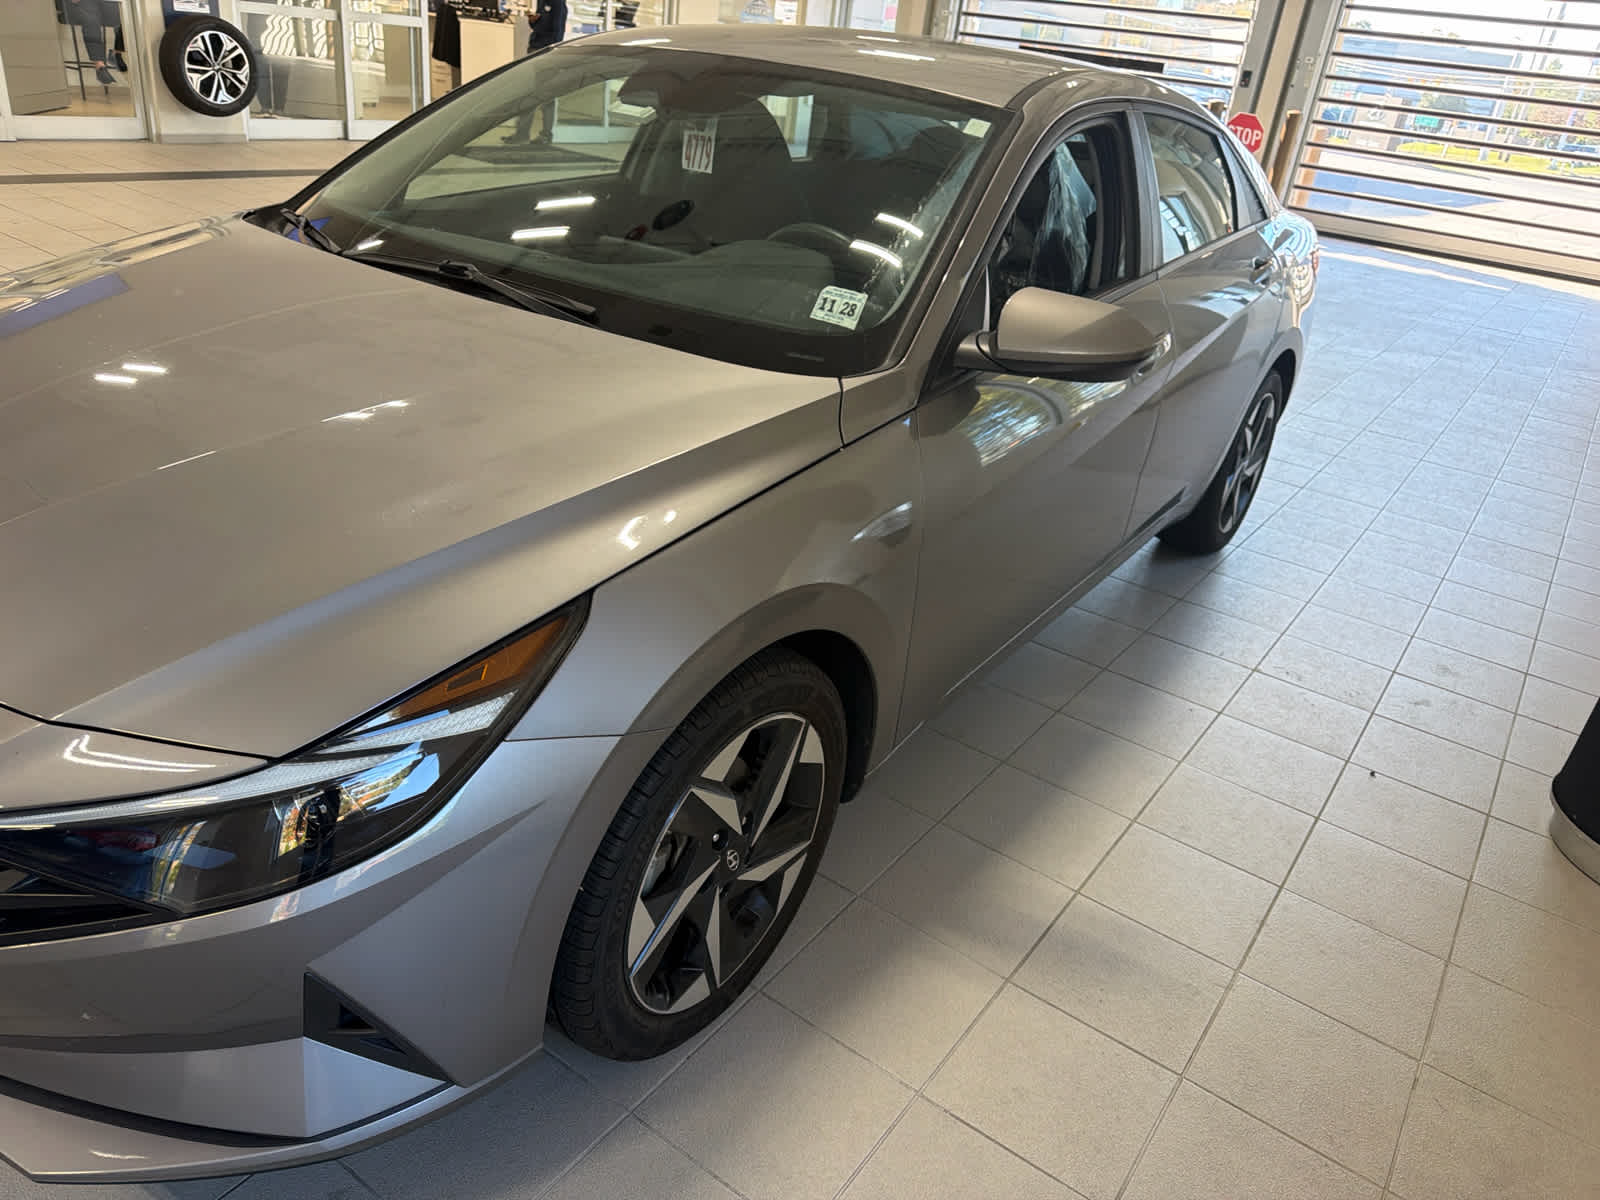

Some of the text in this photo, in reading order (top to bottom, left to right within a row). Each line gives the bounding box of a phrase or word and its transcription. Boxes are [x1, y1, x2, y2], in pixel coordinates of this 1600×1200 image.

[685, 134, 712, 170] 4779
[818, 297, 837, 312] 11
[839, 302, 858, 317] 28
